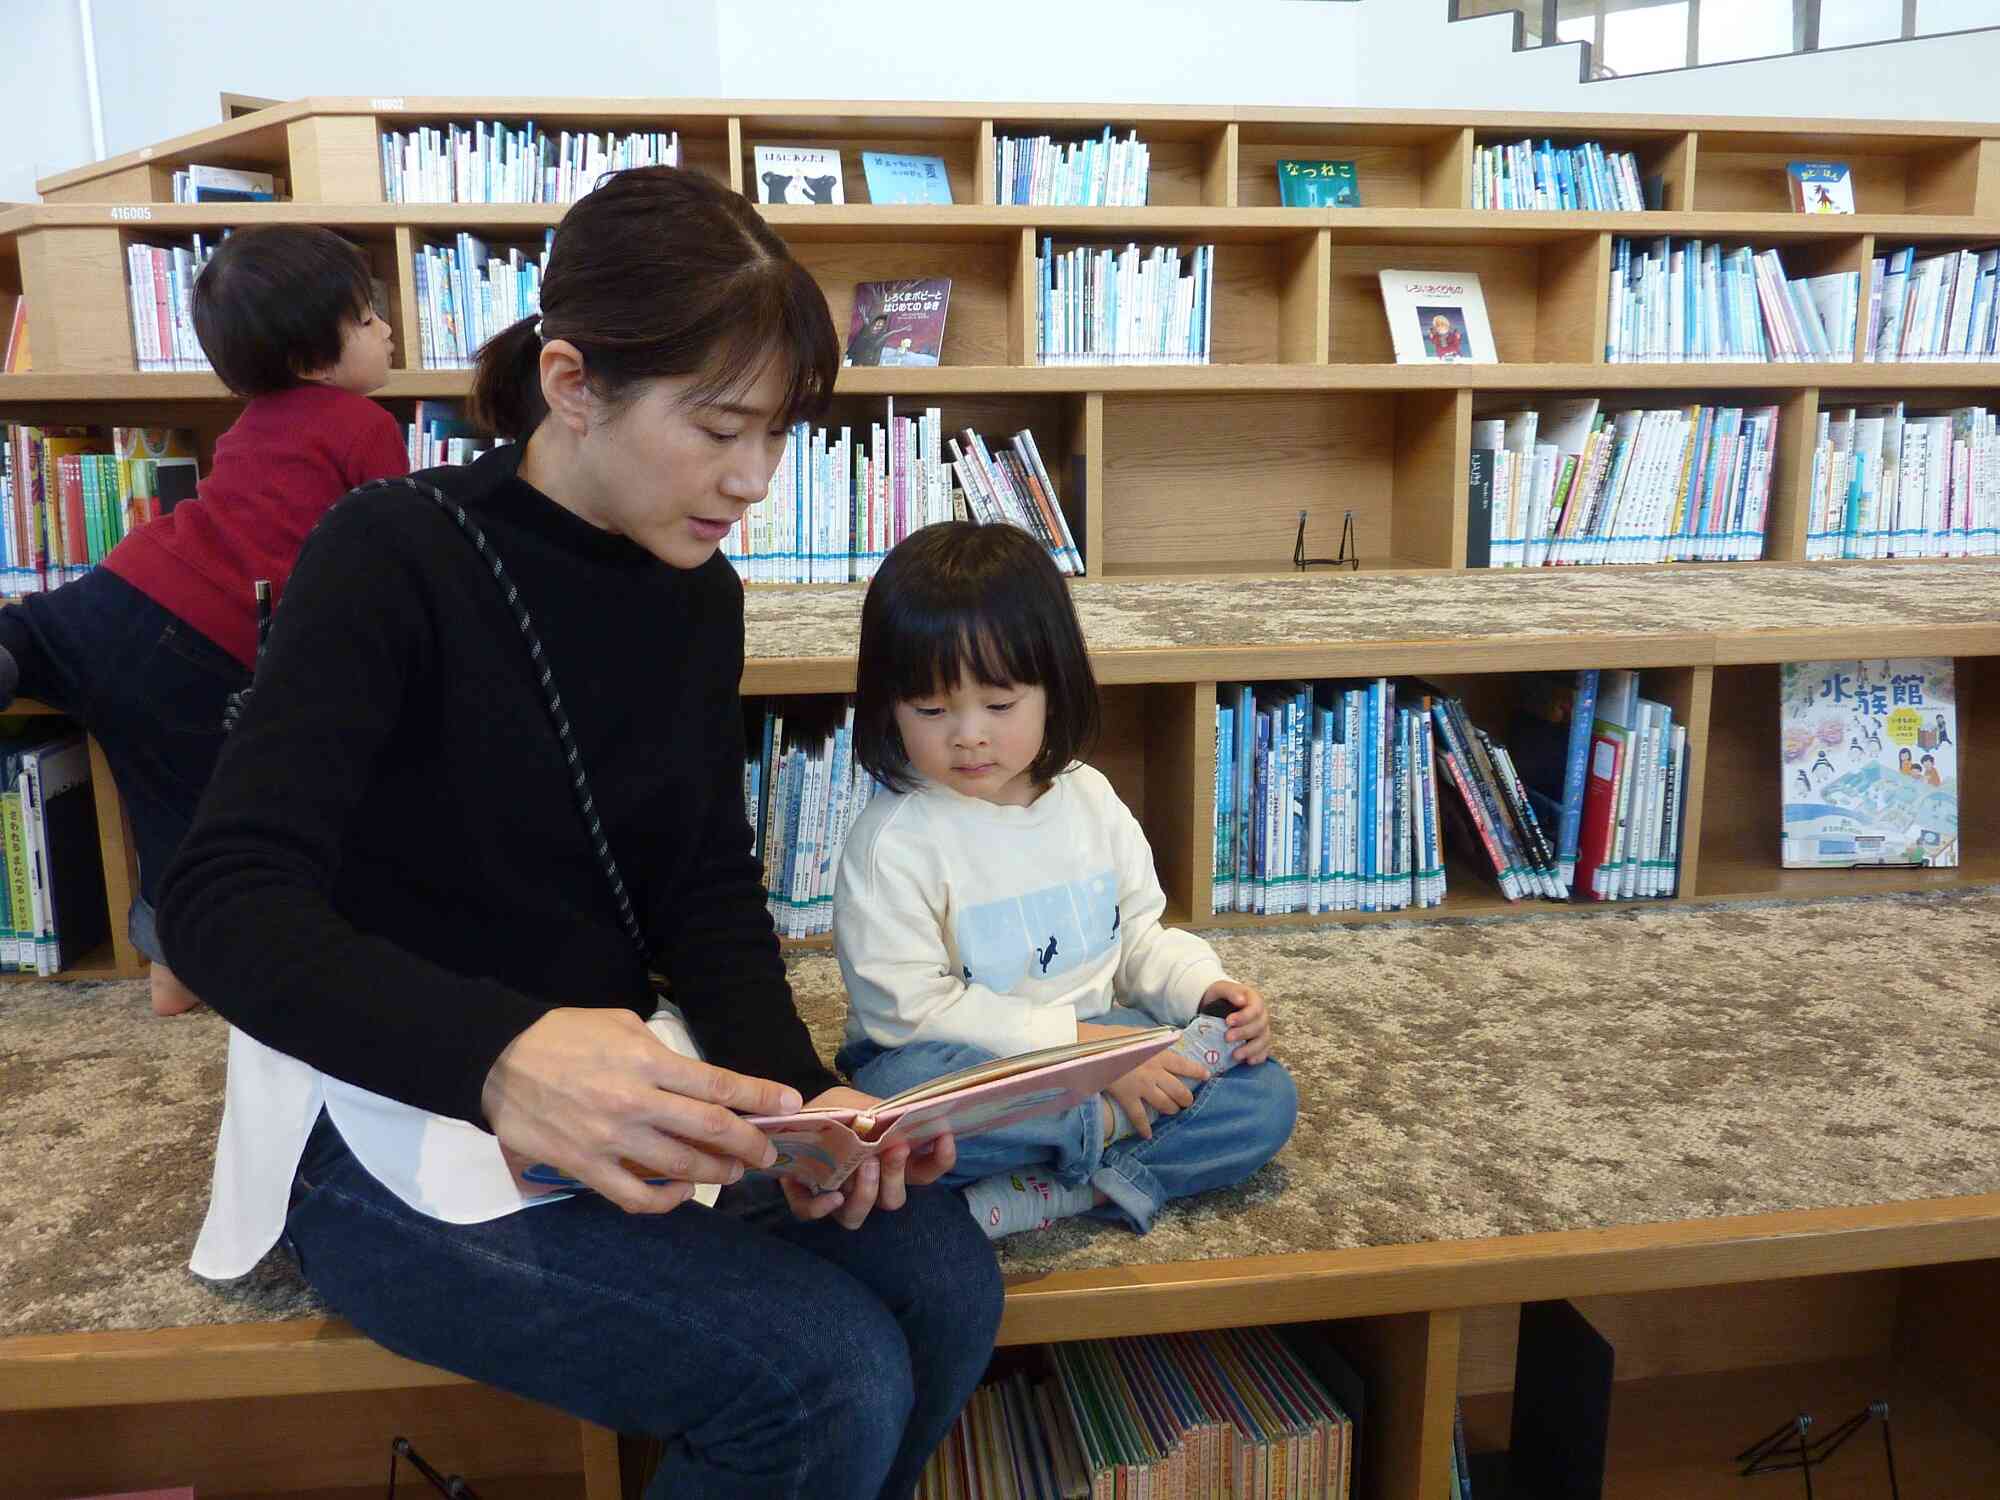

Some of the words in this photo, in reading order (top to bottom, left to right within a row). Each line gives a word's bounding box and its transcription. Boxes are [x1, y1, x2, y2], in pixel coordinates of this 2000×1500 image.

[1285, 161, 1351, 178] なつねこ
[1820, 673, 1925, 715] 水族館
